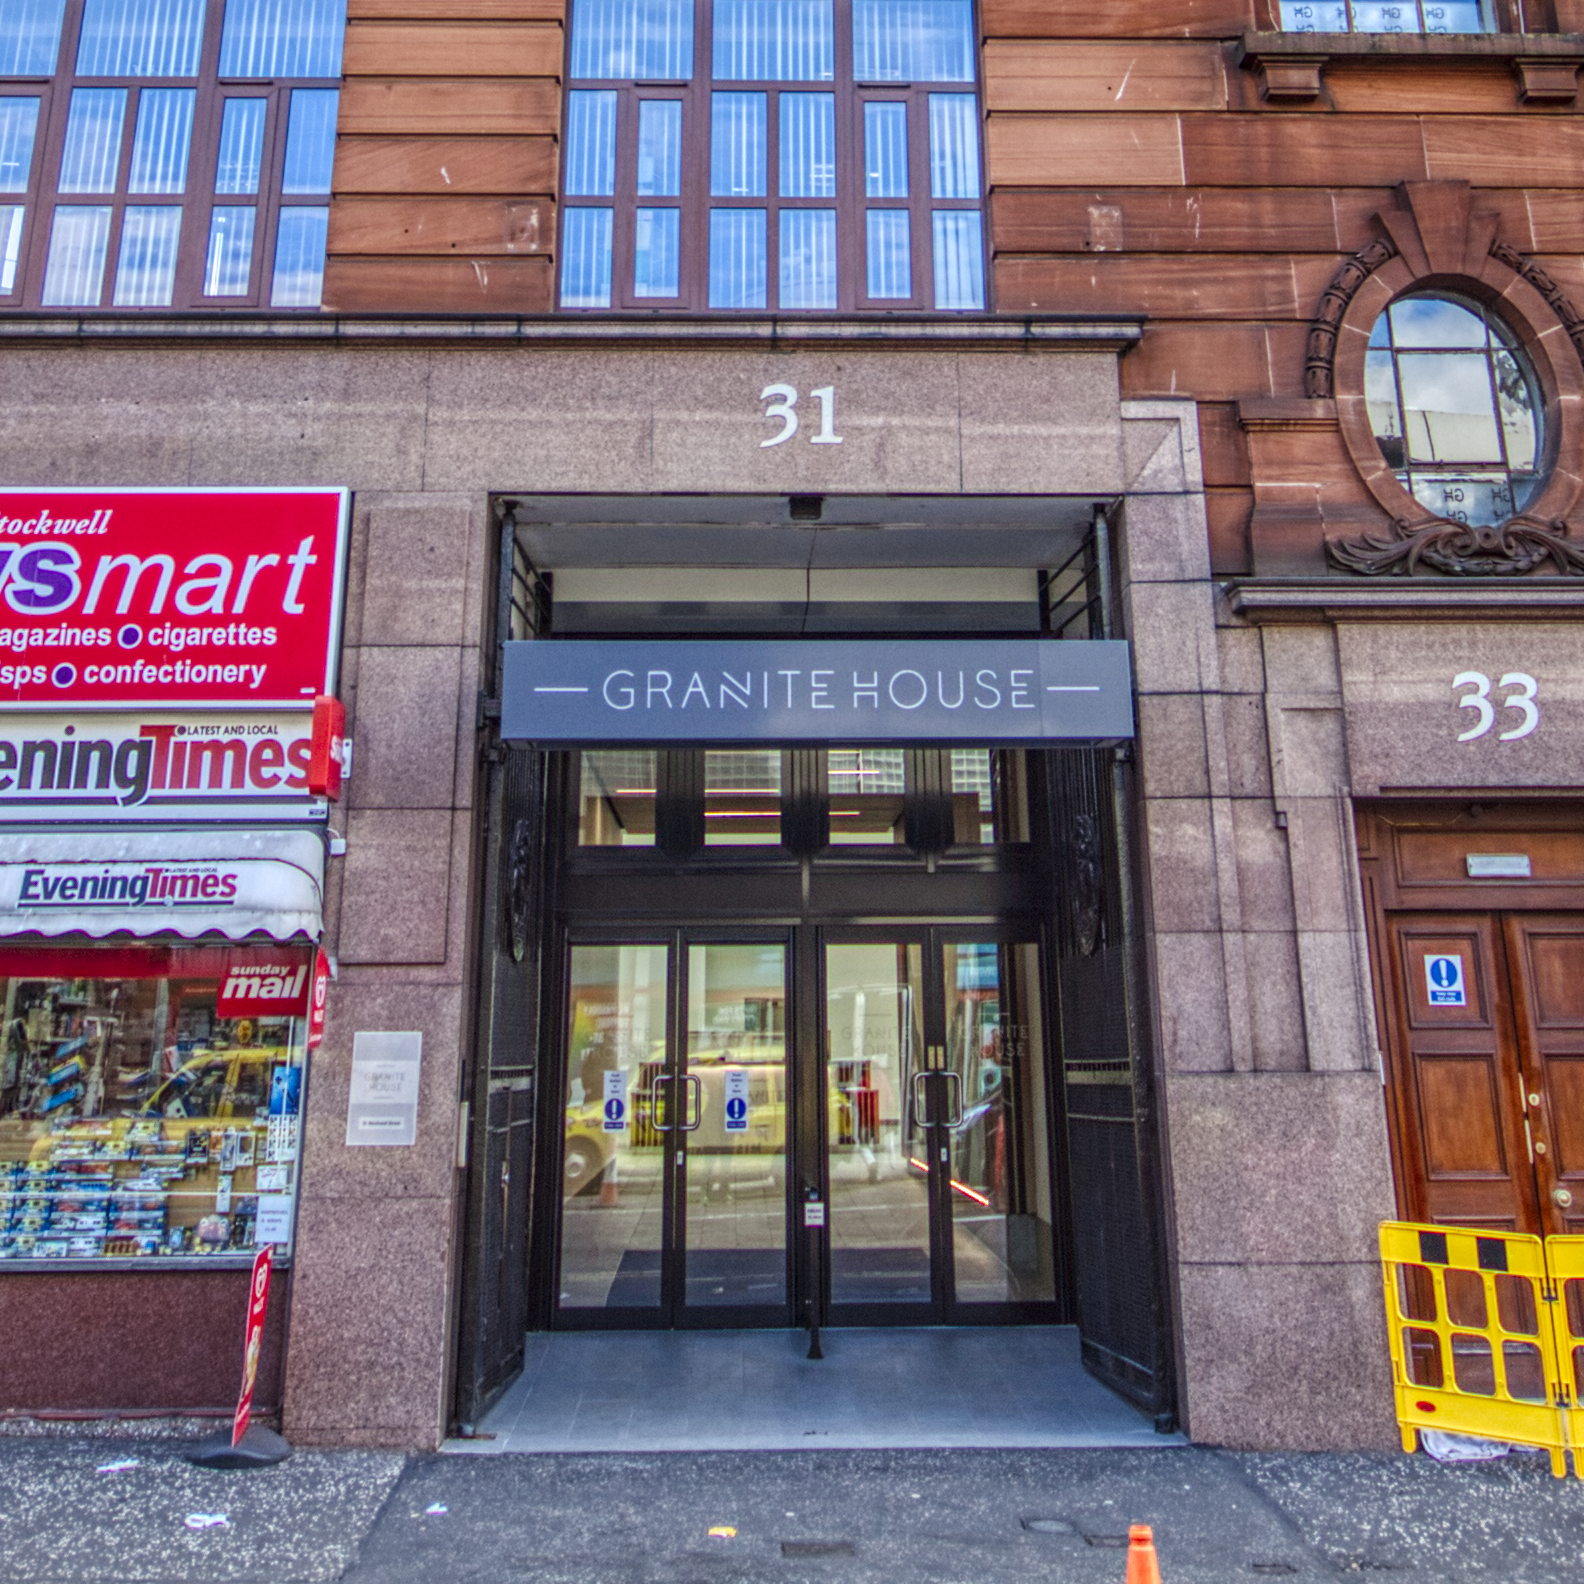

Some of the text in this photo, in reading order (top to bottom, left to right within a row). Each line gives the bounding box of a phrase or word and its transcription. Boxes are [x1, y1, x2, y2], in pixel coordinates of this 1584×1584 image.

[759, 382, 844, 448] 31
[147, 623, 278, 650] cigarettes
[83, 659, 267, 689] confectionery
[603, 669, 1035, 709] GRANITE HOUSE
[1452, 671, 1539, 741] 33
[187, 726, 279, 735] LATEST AND LOCAL
[222, 965, 307, 1000] mail
[230, 965, 291, 976] sunday
